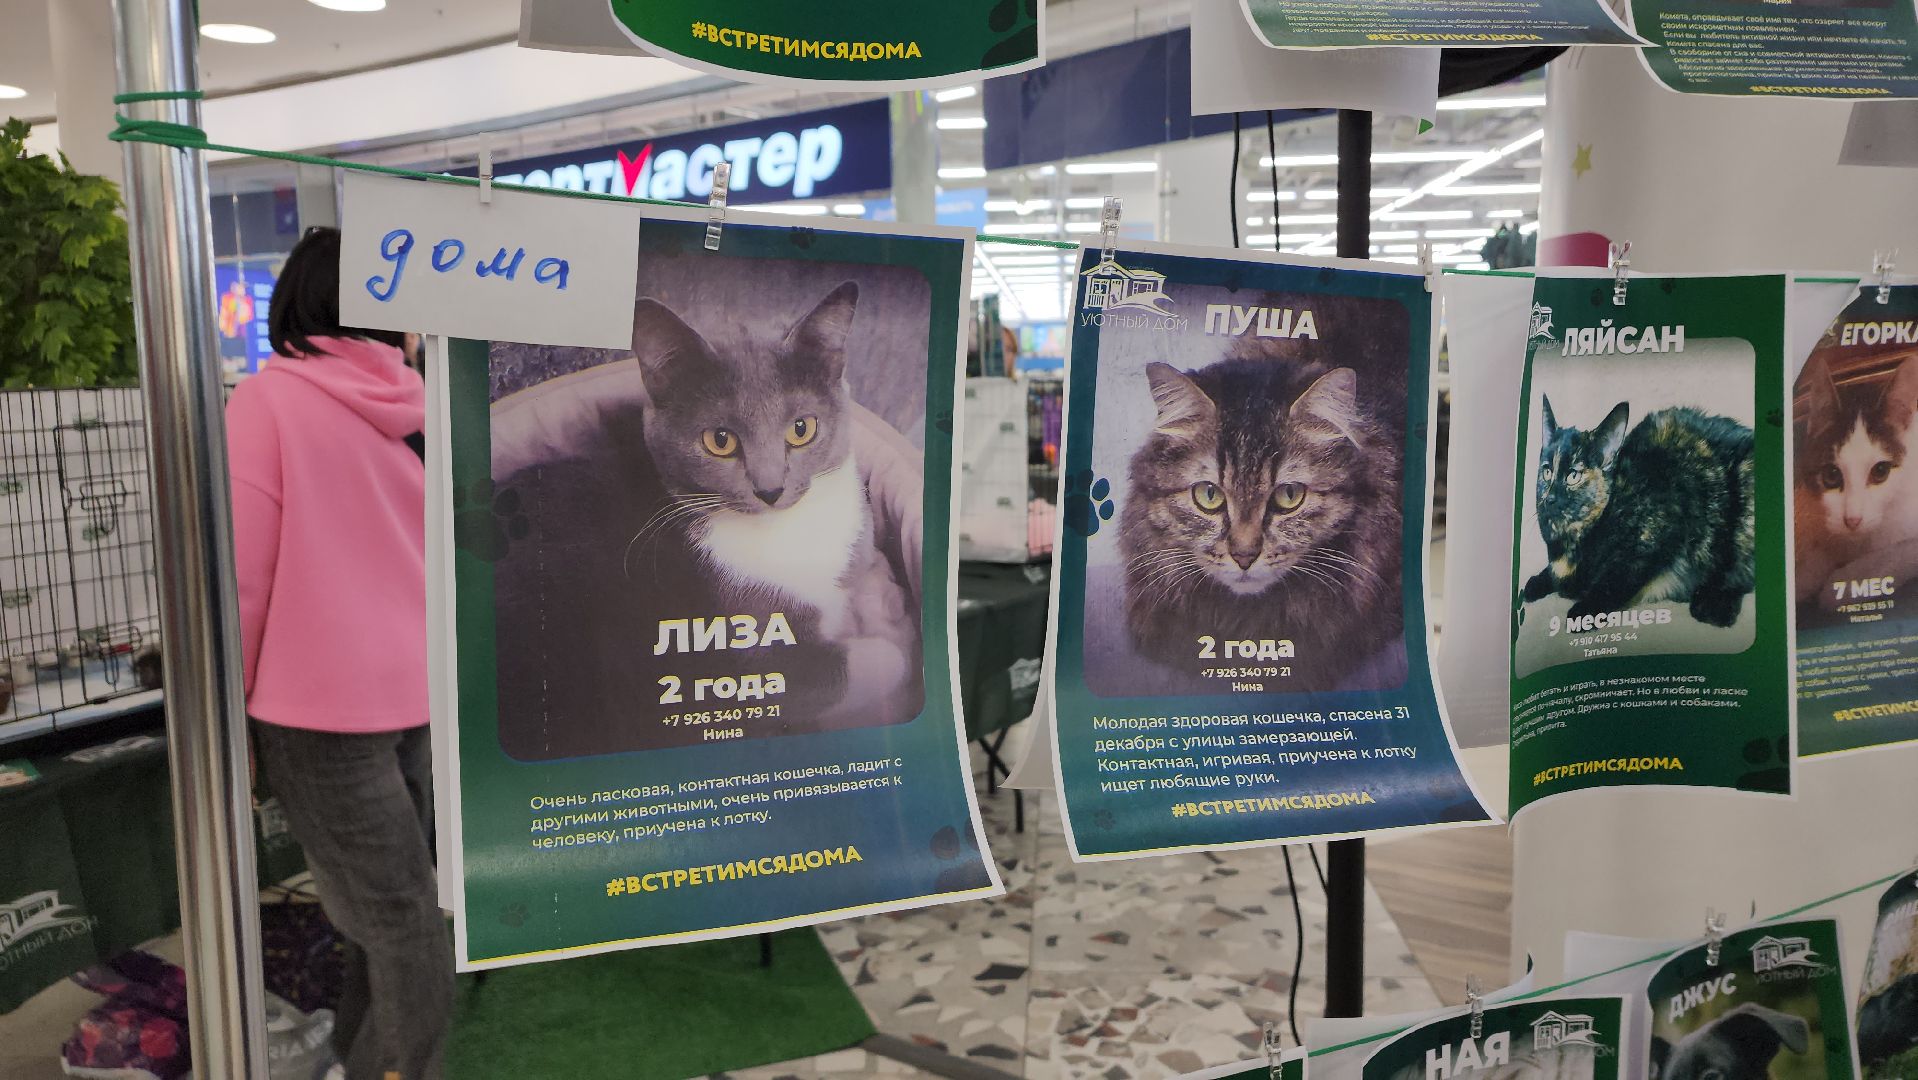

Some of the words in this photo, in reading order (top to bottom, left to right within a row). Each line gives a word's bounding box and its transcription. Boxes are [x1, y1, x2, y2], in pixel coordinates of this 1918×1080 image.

[1660, 12, 1691, 21] Комета,
[1692, 13, 1745, 22] оправдывает
[1661, 22, 1688, 30] своим
[692, 21, 922, 61] #ВСТРЕТИМСЯДОМА
[1366, 33, 1544, 42] #ВСТРЕТИМСЯДОМА
[1749, 86, 1894, 95] #ВСТРЕТИМСЯДОМА
[366, 229, 570, 302] дома
[1080, 312, 1150, 330] УЮТНЫЙ
[1152, 317, 1189, 333] ДОМ
[1204, 304, 1319, 340] ПУША
[1561, 318, 1686, 358] ЛЯЙСАН
[1832, 581, 1848, 600] 7
[1850, 576, 1896, 599] МЕС
[653, 612, 798, 656] ЛИЗА
[1548, 615, 1561, 638] 9
[1566, 609, 1673, 634] месяцев
[1197, 635, 1218, 660] 2
[1224, 638, 1296, 662] года
[1568, 638, 1580, 647] +7
[1580, 636, 1594, 646] 910
[1594, 634, 1609, 644] 417
[1610, 632, 1622, 642] 95
[1624, 631, 1639, 641] 44
[1583, 646, 1618, 658] Татьяна
[1200, 669, 1215, 679] +7
[1216, 668, 1238, 679] 926
[1239, 667, 1262, 678] 340
[1263, 667, 1279, 678] 79
[1280, 666, 1292, 677] 21
[1606, 674, 1671, 687] незнакомом
[1671, 673, 1707, 684] месте
[656, 675, 684, 705] 2
[694, 672, 787, 702] года
[1231, 681, 1265, 693] Нина
[1637, 686, 1652, 697] Но
[1653, 687, 1661, 696] в
[1661, 686, 1700, 697] любви
[1702, 687, 1711, 696] и
[1713, 687, 1749, 698] ласке
[1620, 699, 1669, 709] кошками
[1669, 698, 1679, 708] и
[1679, 696, 1742, 709] собаками.
[1833, 698, 1918, 722] #ВСТРЕТИМС
[661, 713, 681, 728] +7
[683, 711, 712, 727] 926
[713, 708, 742, 723] 340
[744, 706, 765, 720] 79
[766, 704, 781, 718] 21
[1093, 715, 1168, 732] Молодая
[1171, 712, 1250, 731] здоровая
[1252, 710, 1327, 729] кошечка,
[1328, 709, 1393, 727] спасена
[1394, 706, 1411, 720] 31
[703, 727, 745, 741] Нина
[1094, 733, 1166, 753] декабря
[1168, 737, 1179, 749] с
[1181, 735, 1236, 754] улицы
[1239, 728, 1359, 748] замерзающей.
[1097, 755, 1200, 773] Контактная,
[1202, 752, 1277, 769] игривая,
[1278, 748, 1358, 768] приучена
[1360, 747, 1373, 760] к
[1374, 744, 1418, 760] лотку
[530, 793, 587, 811] Очень
[591, 784, 675, 804] ласковая,
[678, 773, 770, 794] контактная
[773, 764, 844, 783] кошечка,
[847, 757, 892, 774] ладит
[893, 757, 903, 768] с
[1101, 779, 1147, 793] ищет
[1149, 772, 1232, 791] любящие
[1234, 772, 1281, 788] руки.
[1532, 757, 1685, 787] #ВСТРЕТИМСЯДОМА
[530, 811, 610, 833] другими
[613, 798, 719, 821] животными,
[721, 792, 771, 807] очень
[773, 776, 891, 802] привязывается
[893, 775, 903, 786] к
[1171, 791, 1377, 818] #ВСТРЕТИМСЯДОМА
[532, 829, 620, 850] человеку,
[623, 817, 707, 841] приучена
[710, 816, 722, 828] к
[723, 809, 773, 826] лотку.
[606, 845, 864, 897] #ВСТРЕТИМСЯДОМА
[1668, 972, 1737, 1024] ДЖУС
